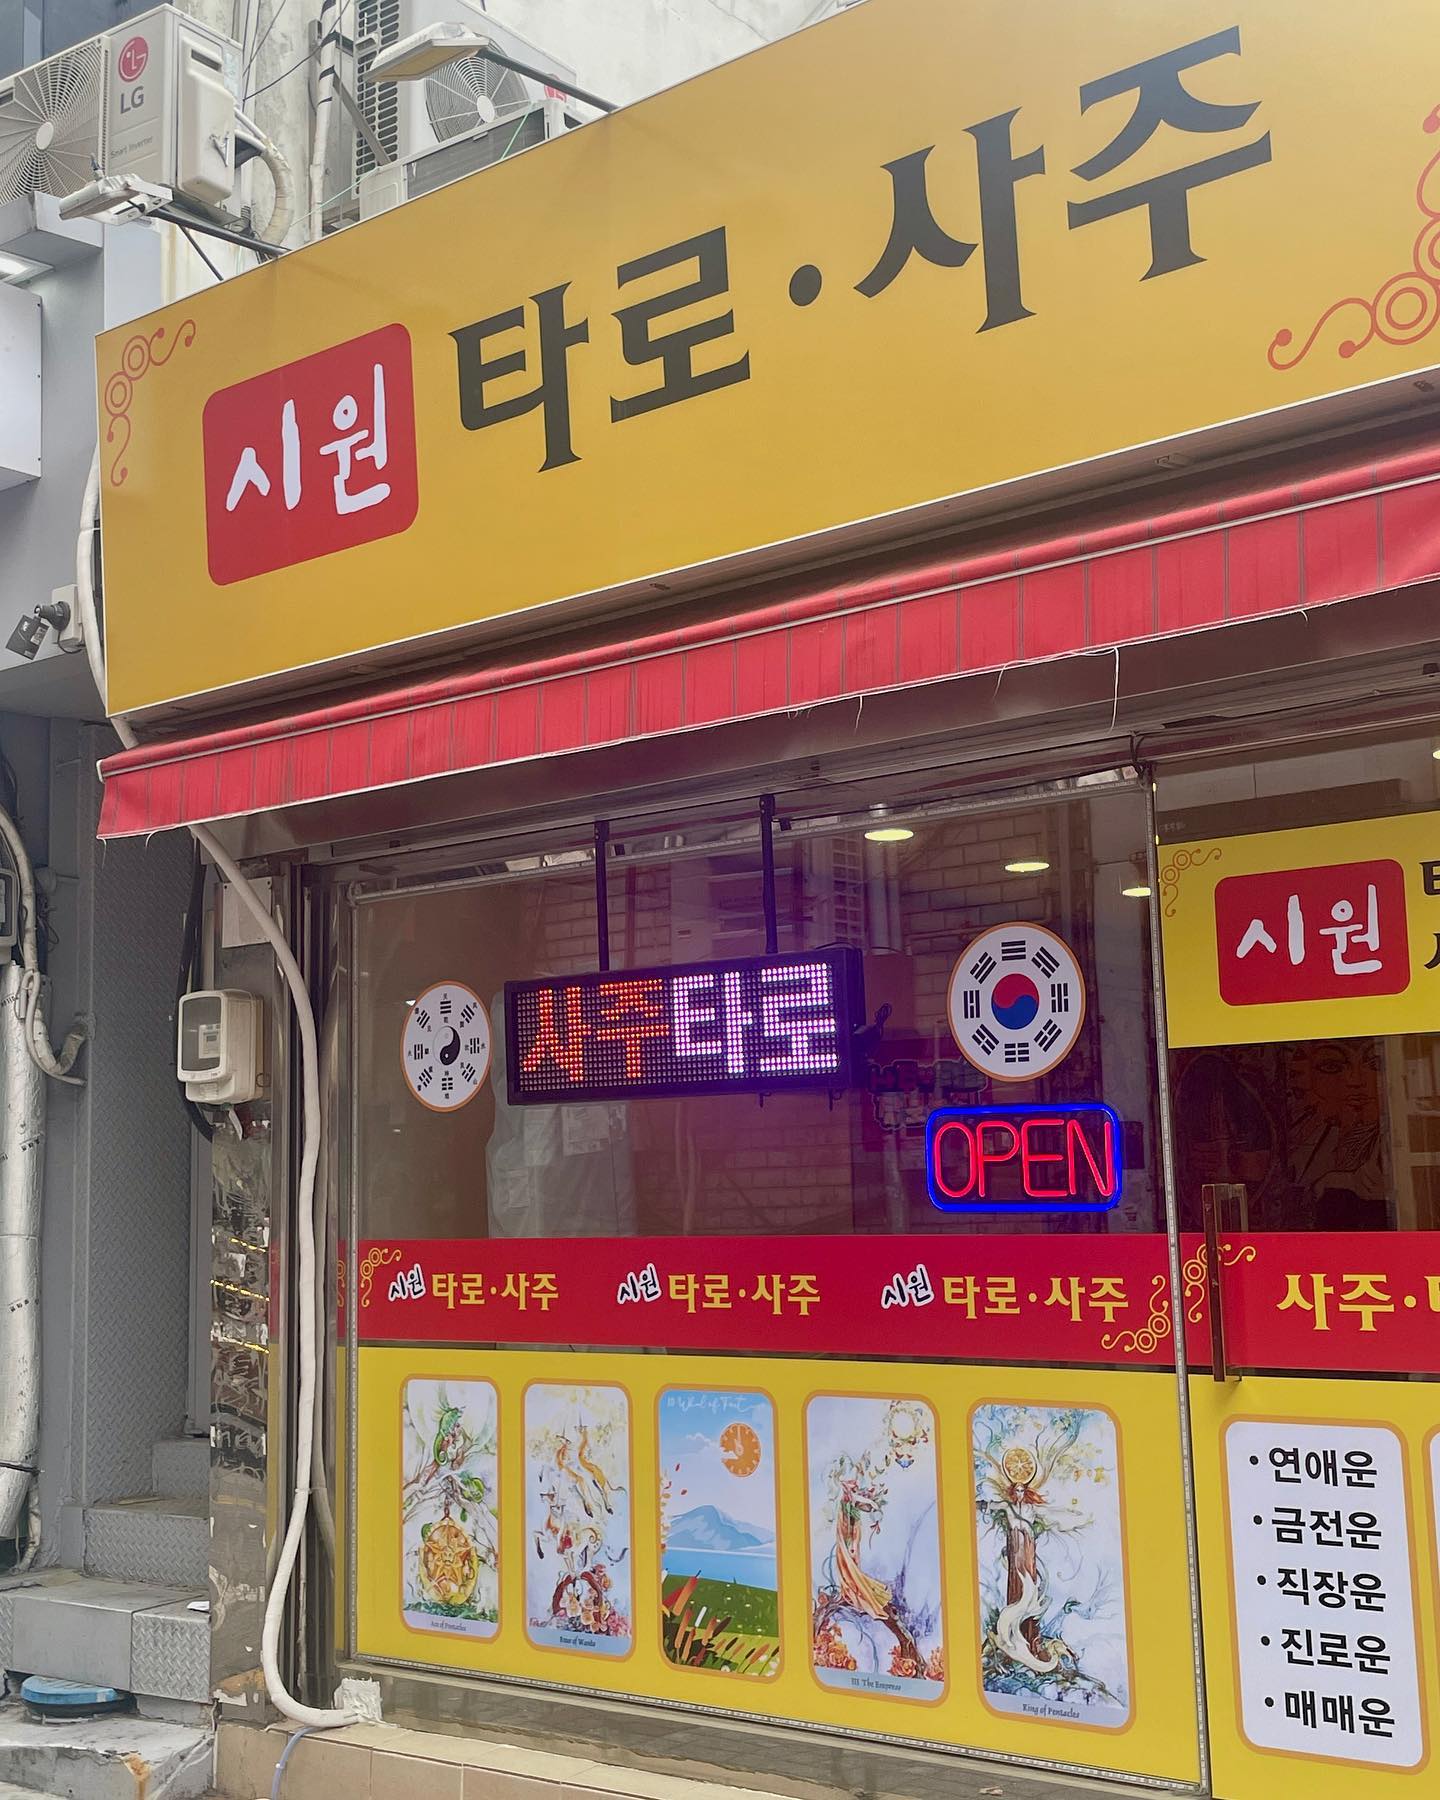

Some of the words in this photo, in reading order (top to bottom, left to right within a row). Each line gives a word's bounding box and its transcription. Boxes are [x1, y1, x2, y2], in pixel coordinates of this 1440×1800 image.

[120, 86, 145, 114] LG
[225, 362, 392, 516] 시원
[1235, 883, 1383, 976] 시원
[933, 1118, 1115, 1198] OPEN
[388, 1264, 426, 1301] 시원
[617, 1264, 661, 1303] 시원
[881, 1264, 934, 1309] 시원
[1268, 1446, 1378, 1488] 연애운
[1271, 1506, 1382, 1550] 금전운
[1276, 1567, 1387, 1613] 직장운
[1280, 1628, 1391, 1675] 진로운
[861, 1676, 874, 1688] The
[1022, 1703, 1039, 1715] King
[1039, 1703, 1047, 1717] of
[1048, 1706, 1081, 1719] Pentacles
[1284, 1689, 1395, 1738] 매매운
